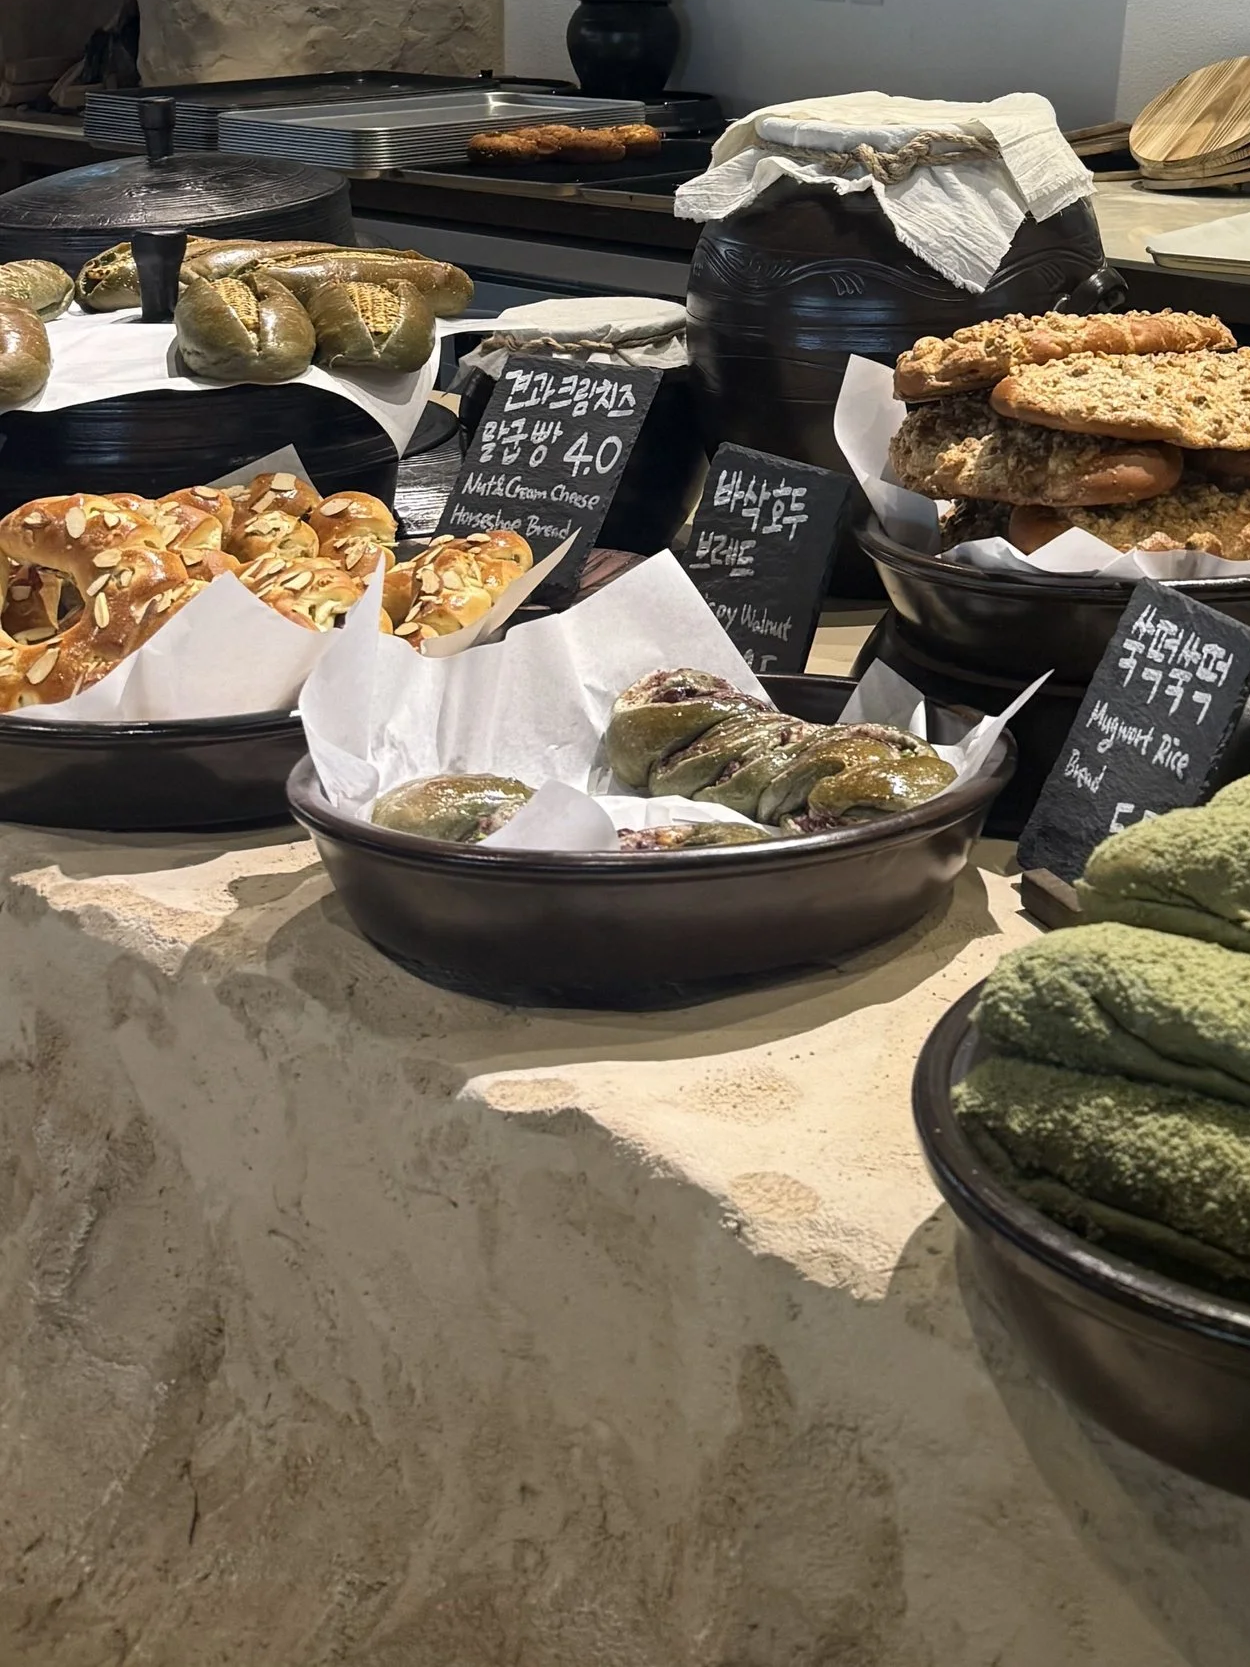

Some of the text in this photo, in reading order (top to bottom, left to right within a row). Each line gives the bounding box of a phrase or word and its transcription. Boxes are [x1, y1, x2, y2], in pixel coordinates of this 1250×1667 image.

[504, 369, 637, 417] 견과크림치즈
[478, 417, 564, 468] 말굽빵
[563, 431, 623, 477] 4.0
[550, 483, 601, 510] Cheese
[713, 469, 809, 541] 바삭호두
[525, 514, 573, 540] Bread
[740, 603, 793, 642] Walnut
[1151, 733, 1190, 780] Rice
